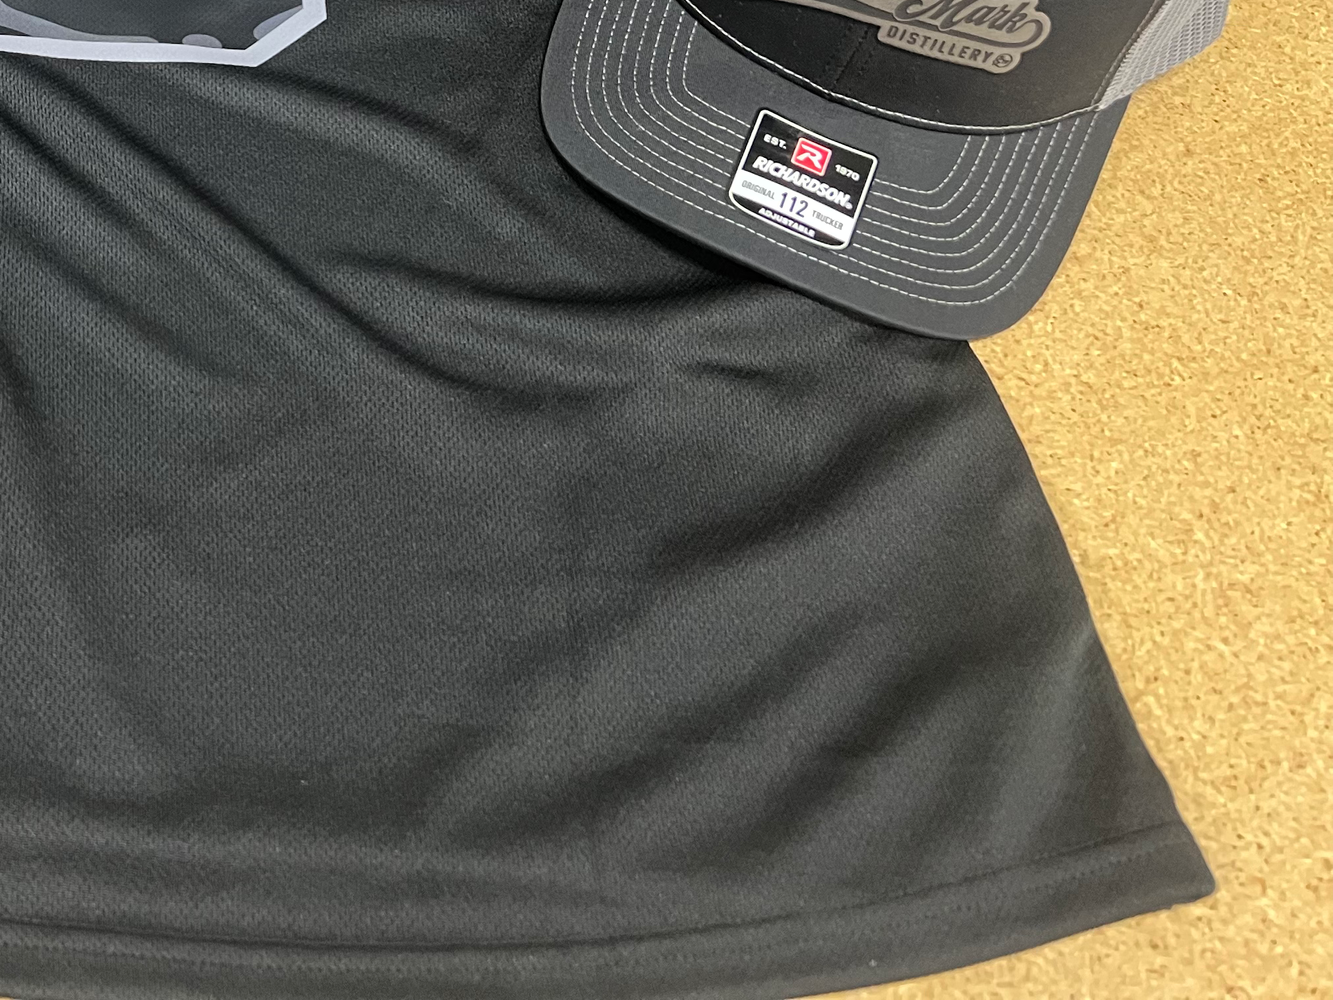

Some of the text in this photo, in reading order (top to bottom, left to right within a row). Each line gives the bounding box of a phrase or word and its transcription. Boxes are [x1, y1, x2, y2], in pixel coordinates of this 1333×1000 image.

[886, 24, 994, 65] DISTILLERY
[752, 155, 852, 209] RICHARDSON
[763, 133, 787, 150] EST.
[835, 163, 861, 182] 1970
[741, 179, 844, 231] ORIGINAL 112 TRUCKER
[758, 207, 816, 238] ADJUSTABLE
